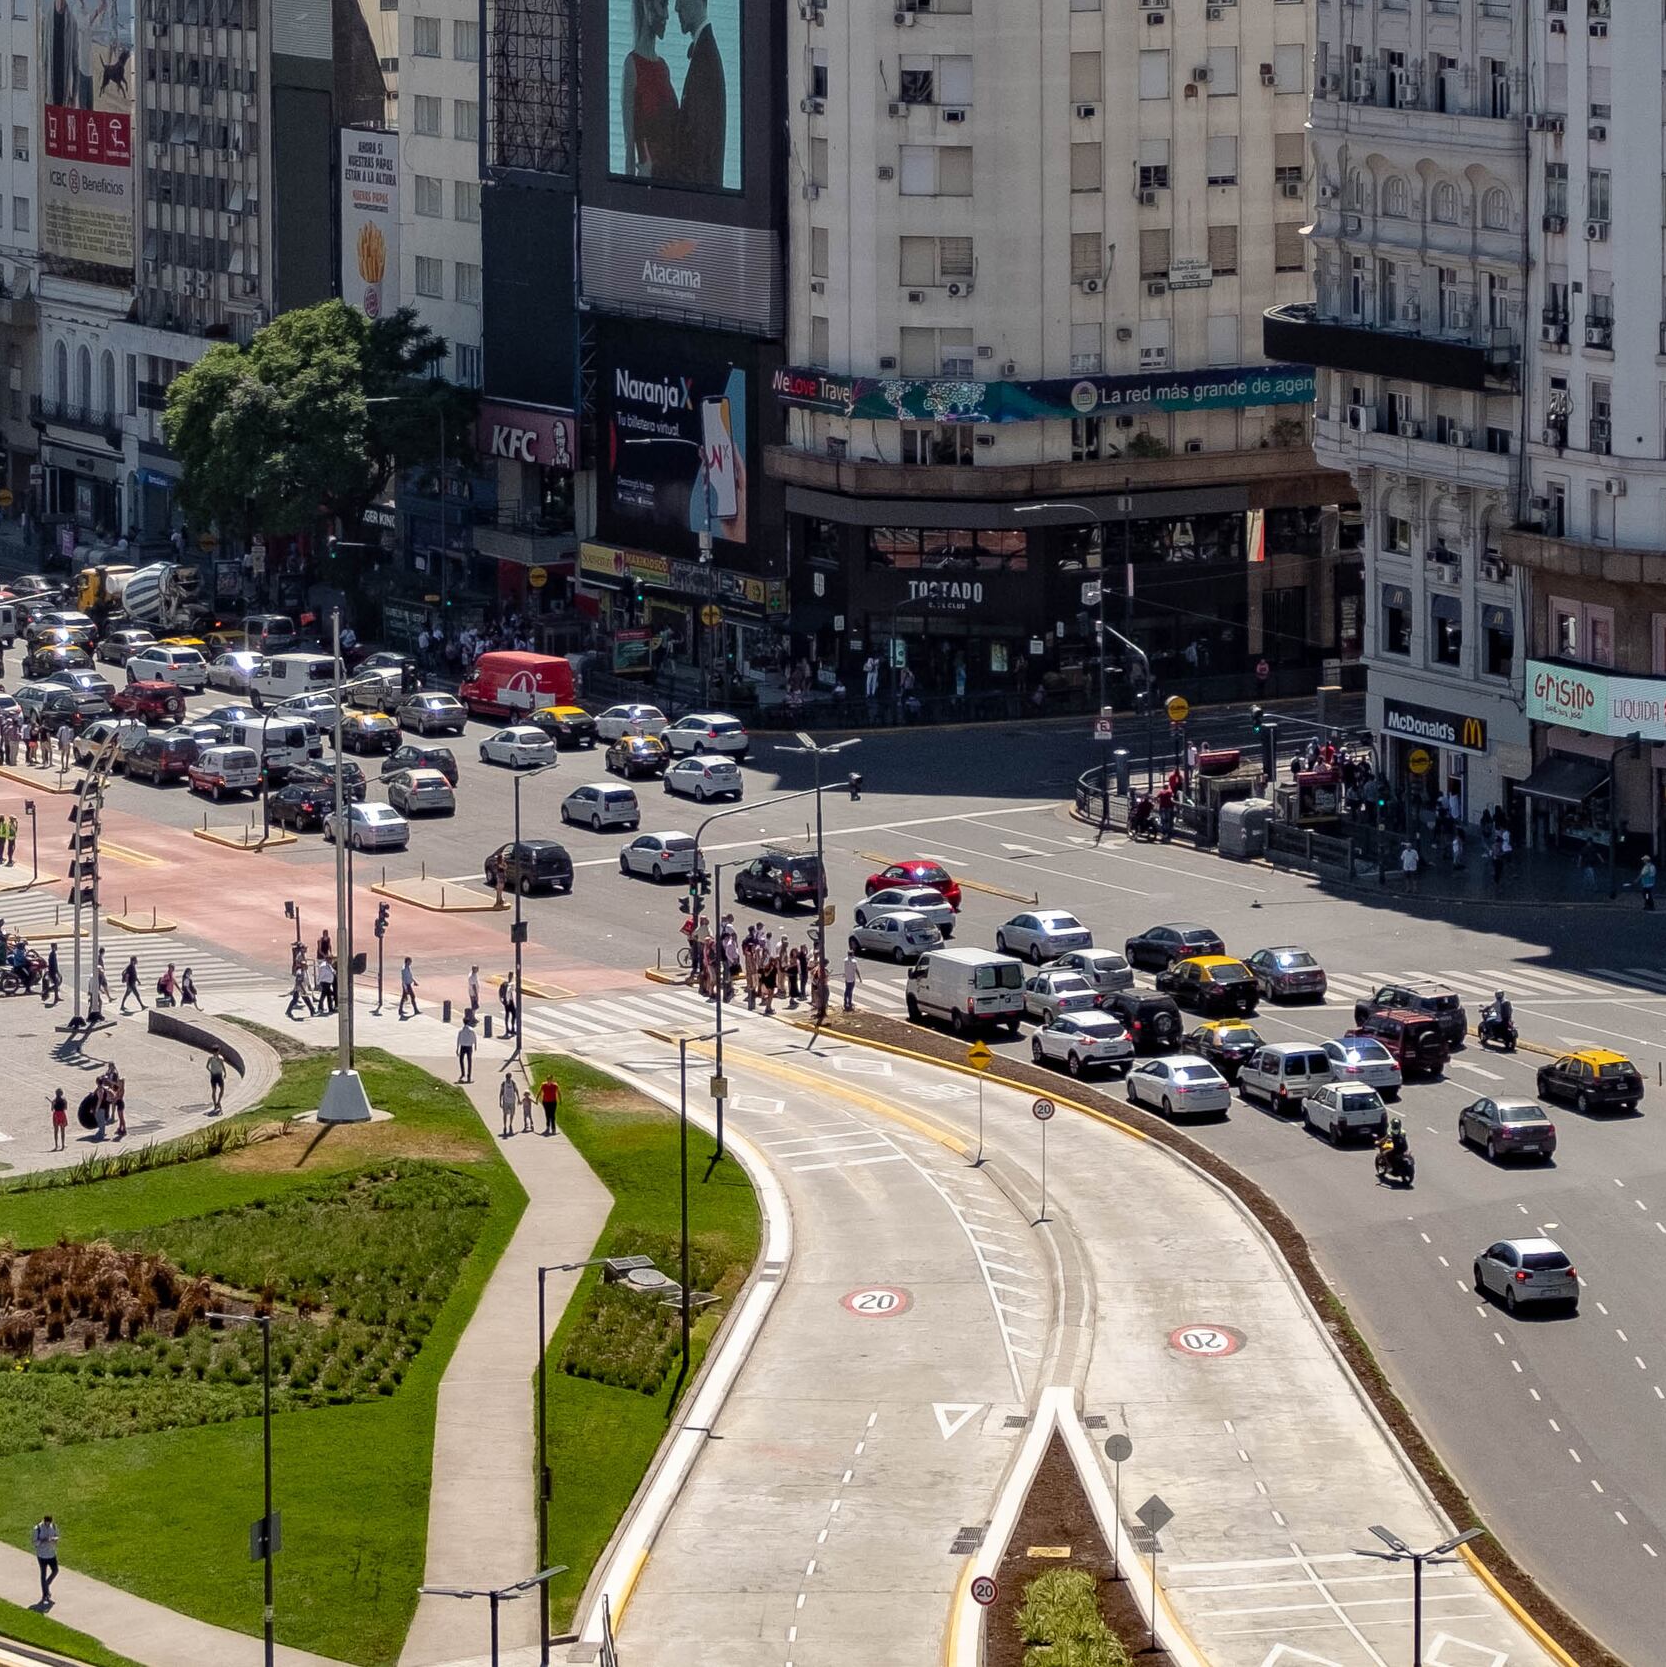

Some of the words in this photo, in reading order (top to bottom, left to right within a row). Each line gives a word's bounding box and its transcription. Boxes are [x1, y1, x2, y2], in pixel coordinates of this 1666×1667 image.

[82, 175, 124, 195] Beneficios
[642, 260, 701, 288] Atacama
[819, 378, 853, 402] Travel
[1102, 388, 1121, 404] La
[1126, 386, 1151, 402] red
[1156, 383, 1188, 400] más
[1193, 380, 1246, 401] grande
[1252, 378, 1270, 394] de
[617, 411, 626, 426] Tu
[627, 413, 656, 432] billetera
[491, 425, 537, 462] KFC
[1535, 673, 1595, 710] Grisino
[1613, 699, 1660, 722] LIQUIDA
[1388, 711, 1455, 741] McDonald's
[1037, 1104, 1052, 1115] 20
[858, 1294, 895, 1310] 20
[1183, 1332, 1222, 1350] 20
[976, 1584, 993, 1598] 20
